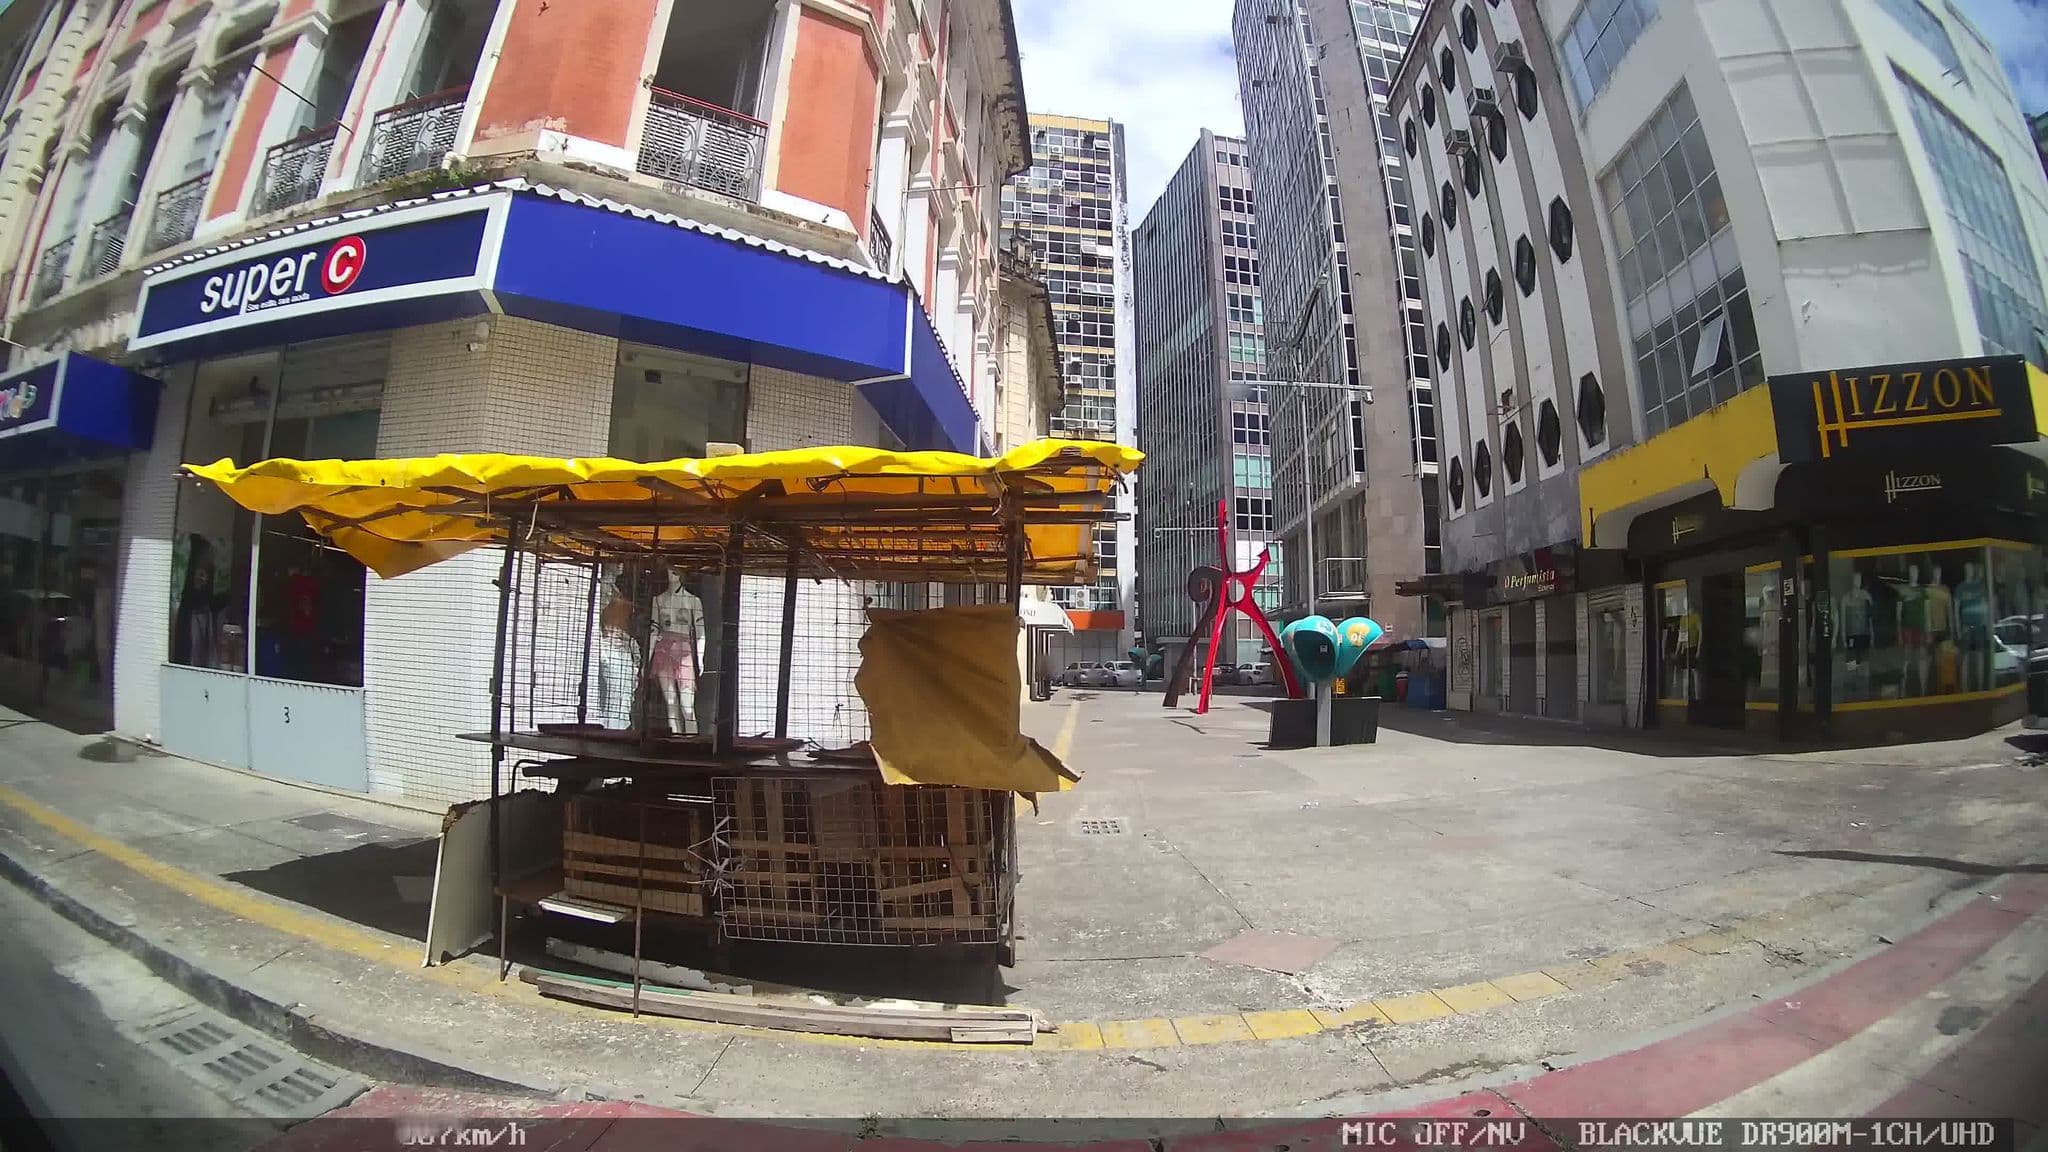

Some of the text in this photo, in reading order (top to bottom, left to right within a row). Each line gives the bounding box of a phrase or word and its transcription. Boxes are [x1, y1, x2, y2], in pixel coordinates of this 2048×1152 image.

[201, 245, 357, 314] super C
[1812, 366, 2001, 458] HIZZON
[1884, 470, 1942, 503] HIZZON
